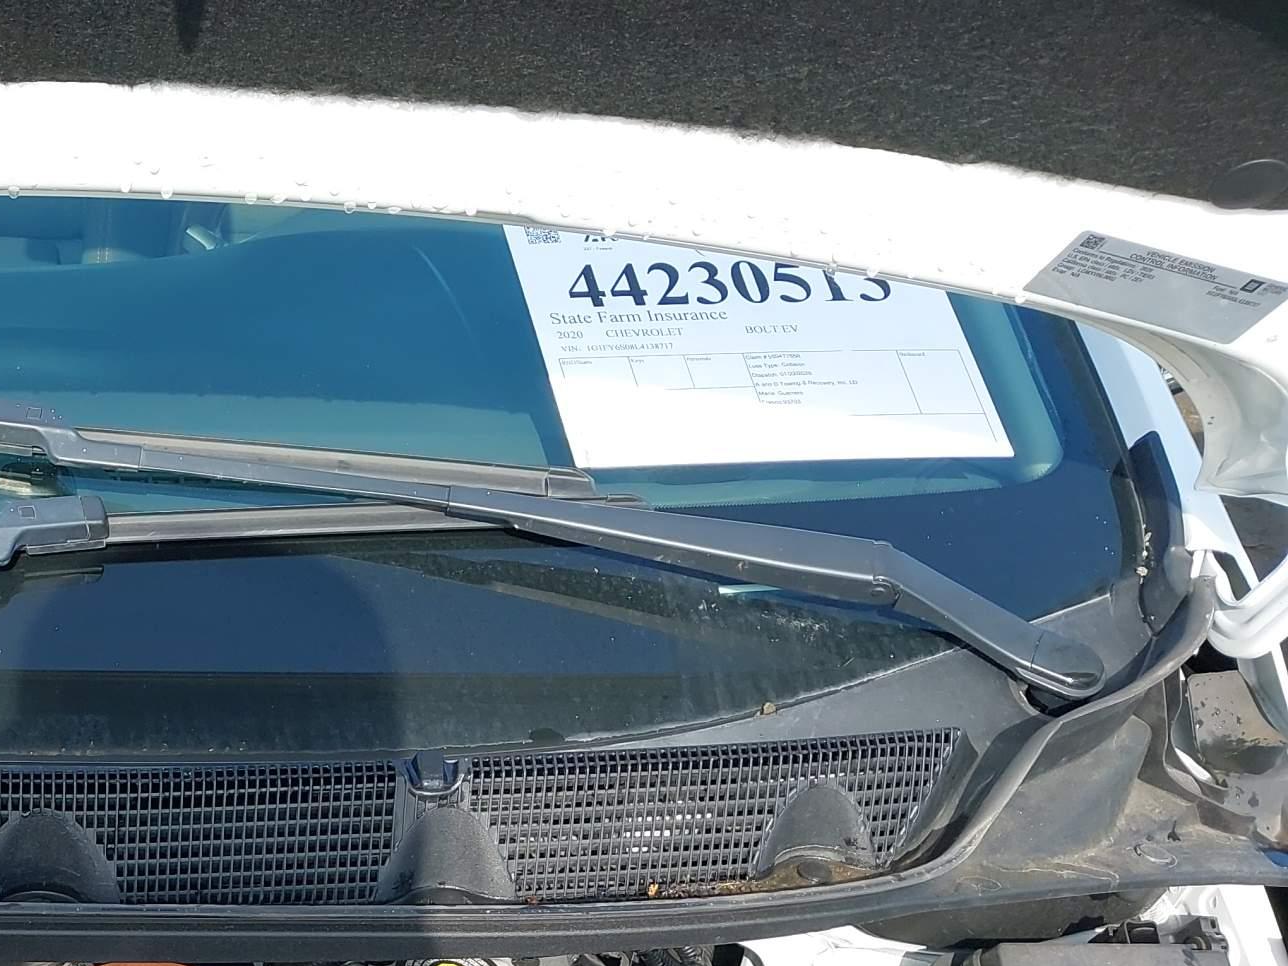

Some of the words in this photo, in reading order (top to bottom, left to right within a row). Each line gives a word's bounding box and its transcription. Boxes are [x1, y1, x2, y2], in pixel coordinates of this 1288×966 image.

[1146, 251, 1178, 263] VEHICLE
[1130, 253, 1164, 268] CONTROL
[1166, 263, 1218, 280] INFORMATION
[549, 312, 593, 325] State
[597, 311, 642, 323] Farm
[647, 309, 728, 323] Insurance
[557, 330, 584, 339] 2020
[605, 327, 684, 339] CHEVROLET
[745, 325, 778, 334] BOLT
[782, 324, 799, 333] EV
